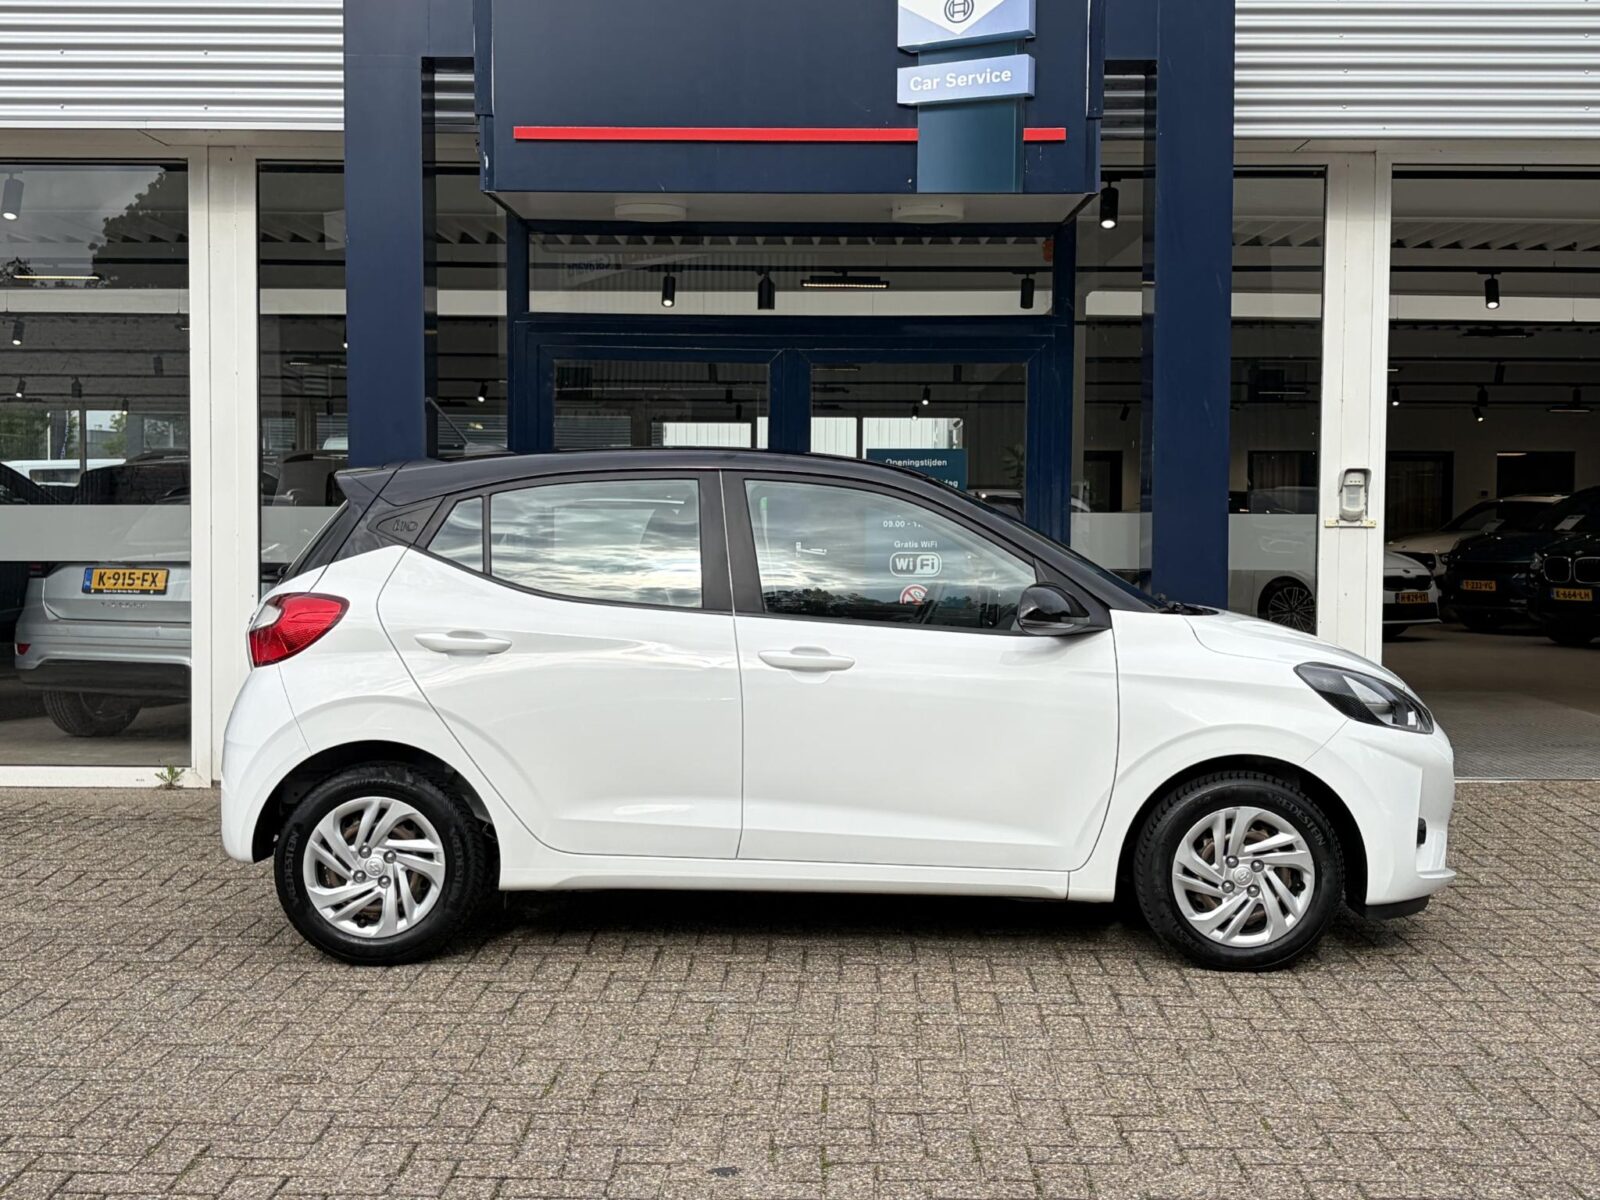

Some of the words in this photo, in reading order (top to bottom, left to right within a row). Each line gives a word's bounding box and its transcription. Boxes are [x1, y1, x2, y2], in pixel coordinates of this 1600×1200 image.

[910, 76, 940, 91] Car
[946, 68, 1011, 88] Service
[894, 540, 919, 548] Gratis
[920, 540, 938, 548] WiFi
[97, 571, 159, 587] K-915-FX
